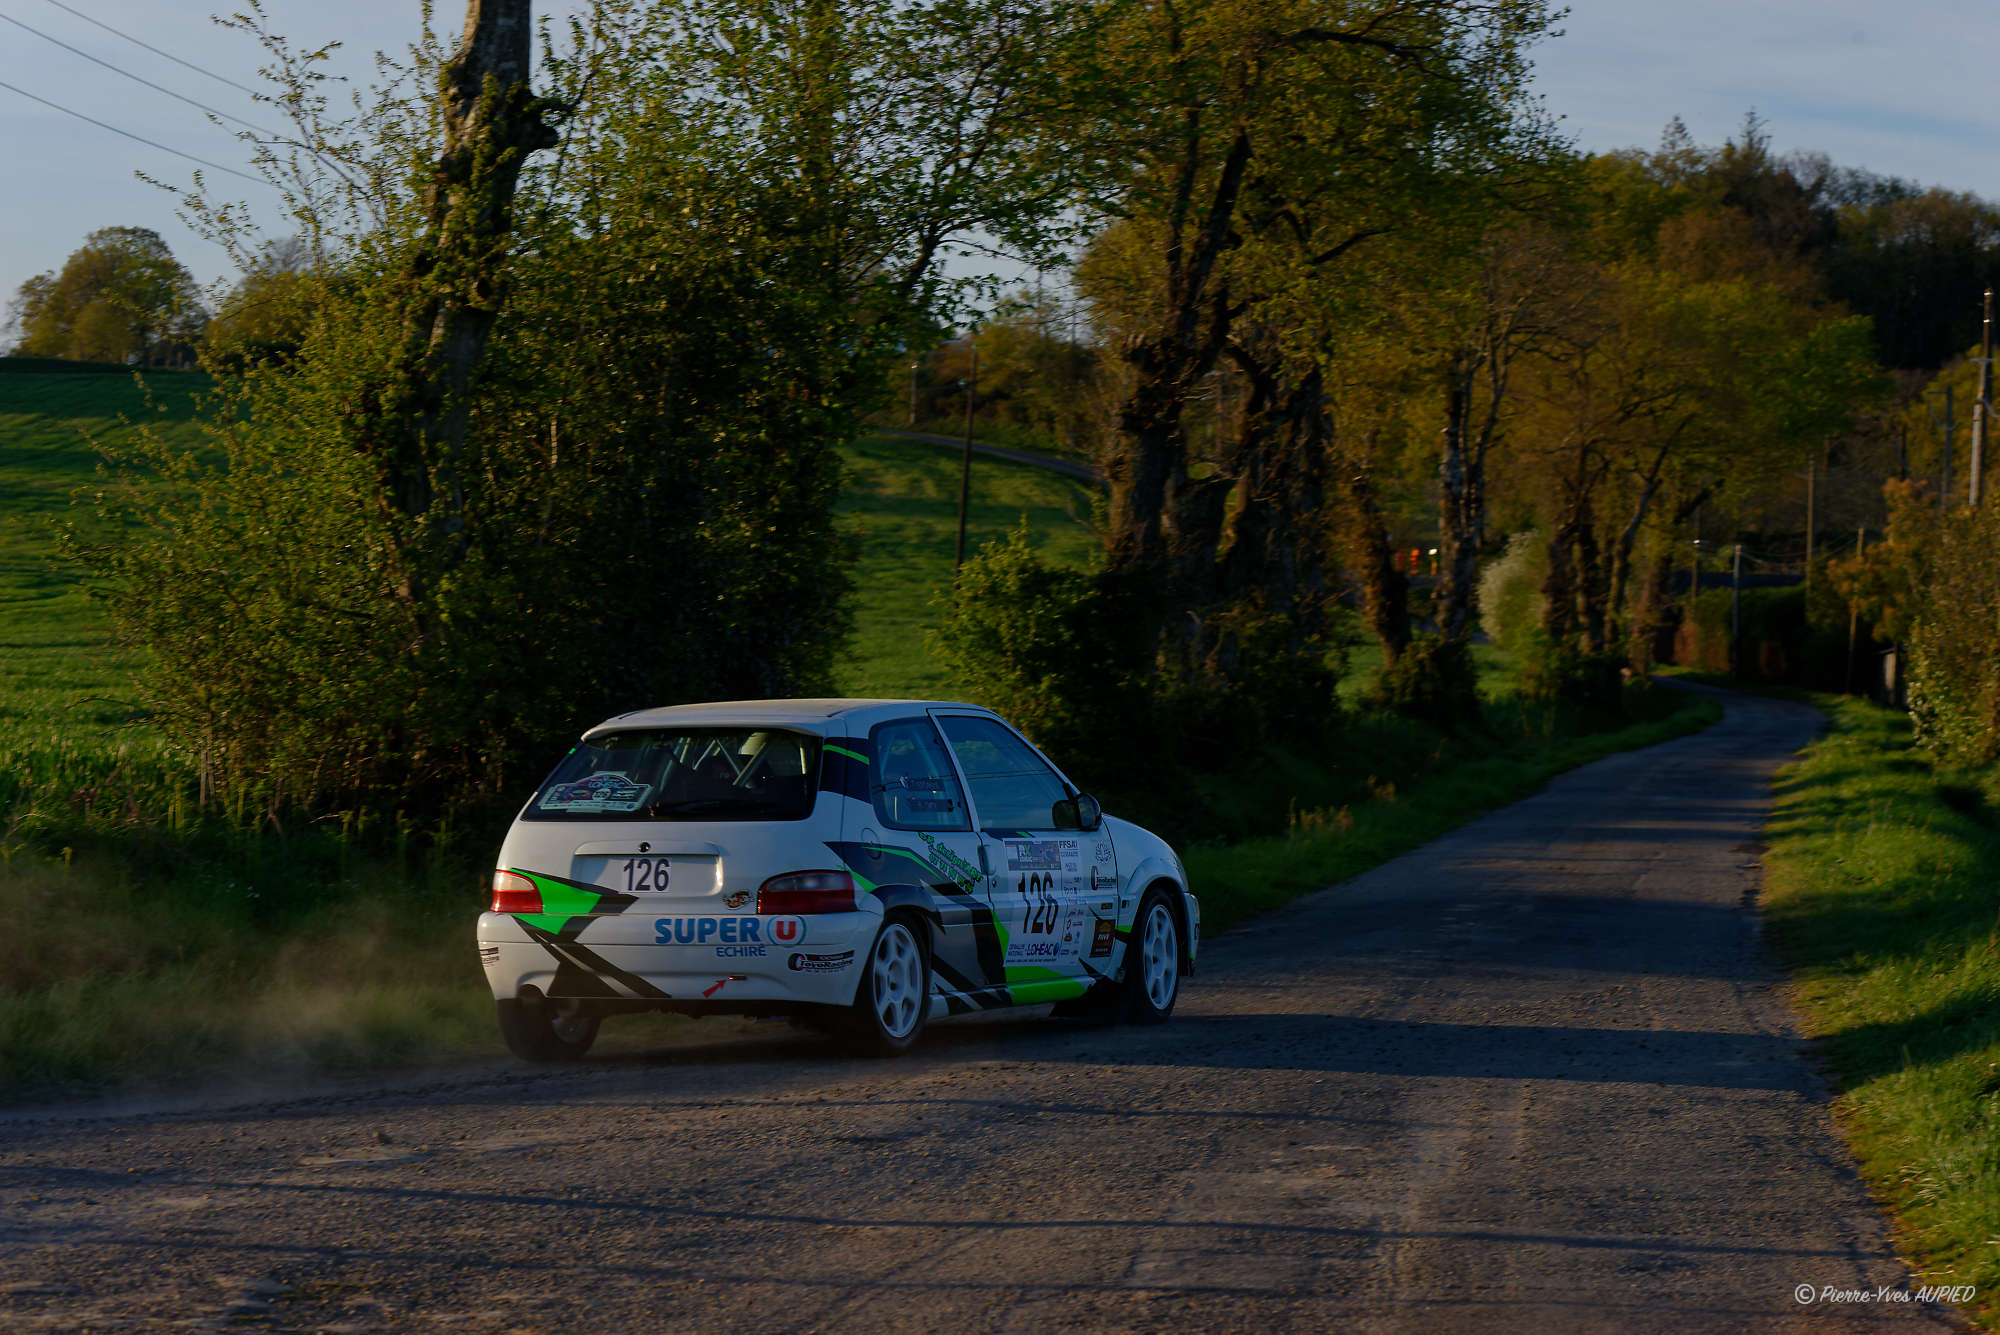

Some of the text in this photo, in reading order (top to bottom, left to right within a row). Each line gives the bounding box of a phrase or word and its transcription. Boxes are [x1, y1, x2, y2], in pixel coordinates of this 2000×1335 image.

[623, 858, 670, 891] 126
[1017, 872, 1059, 935] 126
[654, 917, 796, 943] SUPER U
[716, 944, 766, 957] ECHIRÉ
